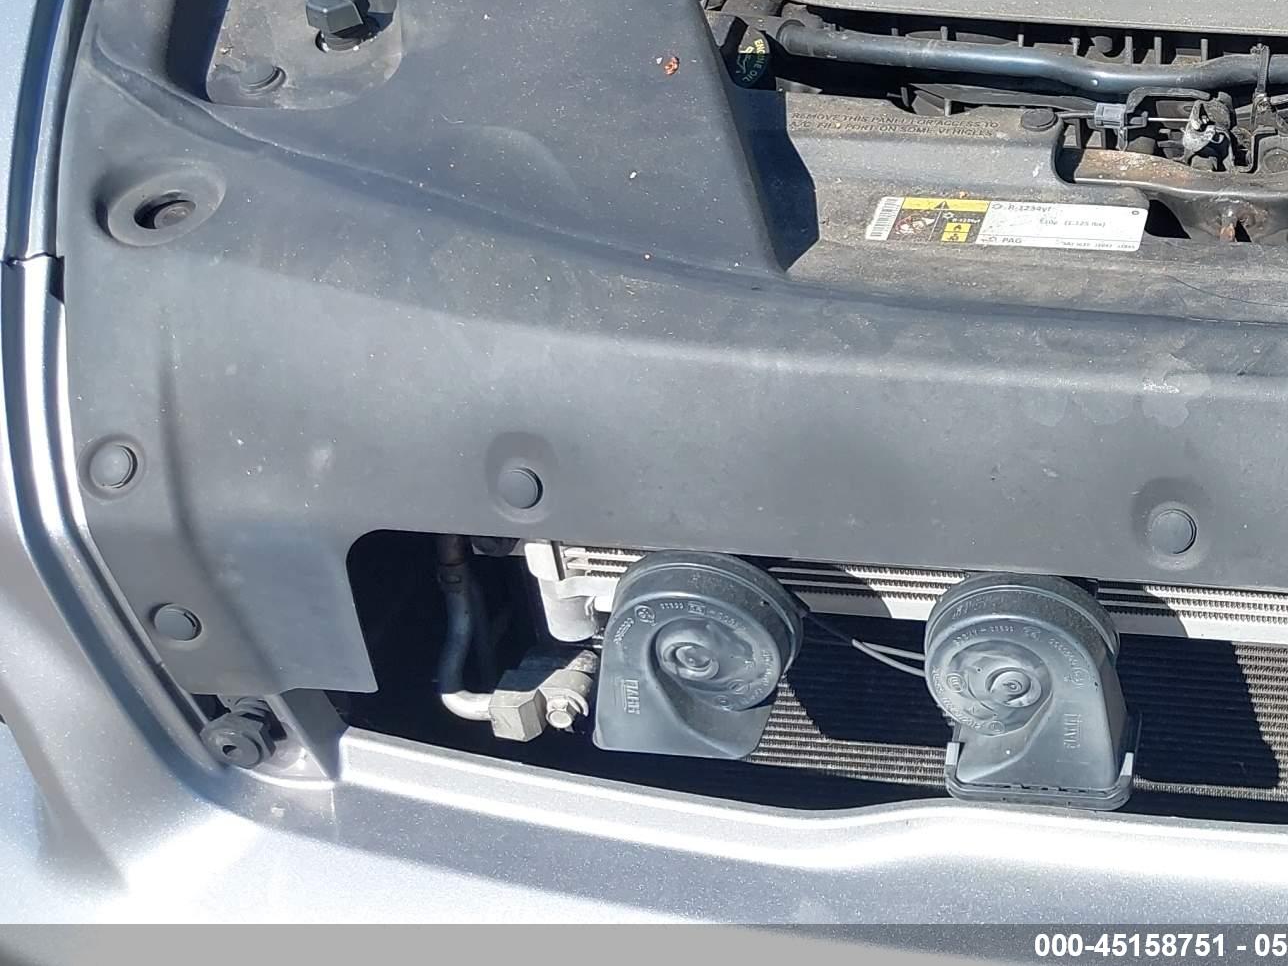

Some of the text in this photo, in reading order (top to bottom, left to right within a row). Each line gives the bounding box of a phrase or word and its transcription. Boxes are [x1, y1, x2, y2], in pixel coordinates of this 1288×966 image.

[742, 38, 766, 82] ENGINE OIL
[791, 112, 999, 129] REMOVE THIS PANEL FOR ACCESS TO
[879, 124, 897, 132] ON
[938, 126, 993, 137] VEHICLES
